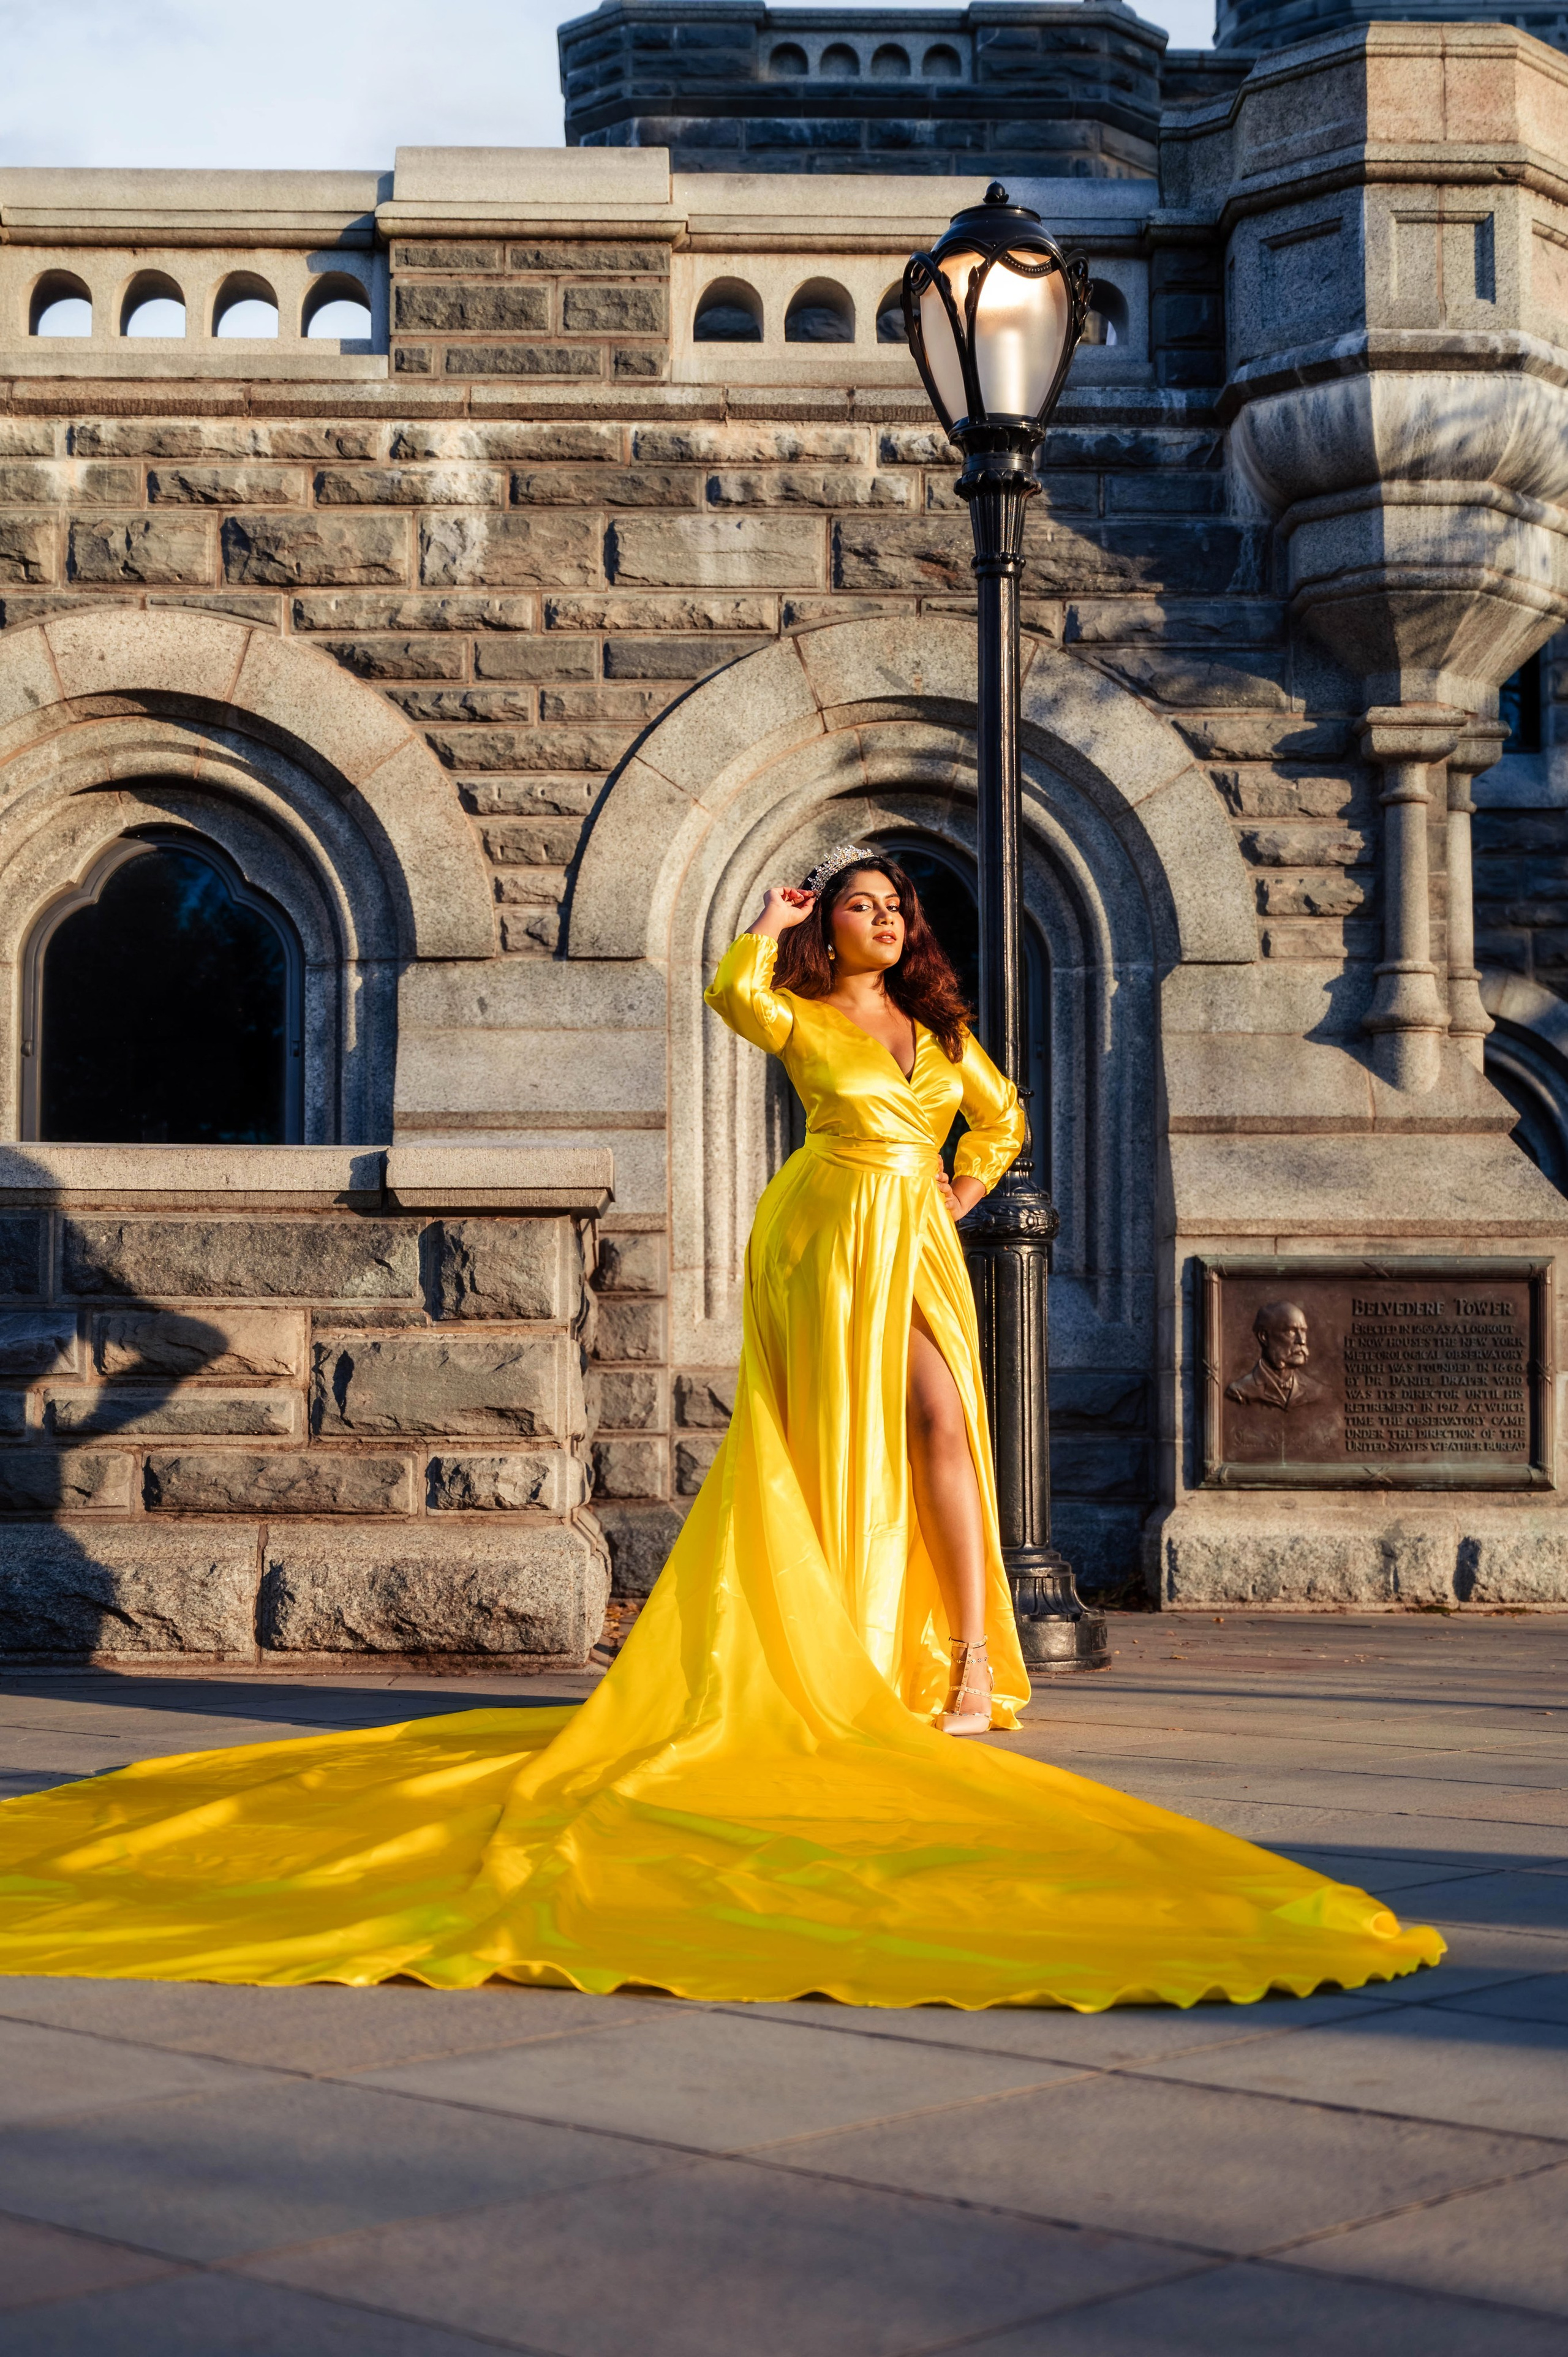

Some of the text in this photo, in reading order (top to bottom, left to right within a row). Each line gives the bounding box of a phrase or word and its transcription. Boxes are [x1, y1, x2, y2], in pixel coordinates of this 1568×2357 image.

[1352, 1298, 1513, 1316] BELVEDERE TOWER
[1352, 1323, 1397, 1335] ERECTED
[1399, 1324, 1409, 1334] IN
[1436, 1324, 1452, 1334] AS
[1452, 1324, 1461, 1334] A
[1463, 1324, 1515, 1335] LOOKOUT
[1344, 1336, 1525, 1348] IT NOW HOUSES THE NEW YORK
[1344, 1349, 1523, 1360] METEOROLOGICAL OBSERVATORY
[1344, 1363, 1385, 1373] WHICH
[1389, 1363, 1414, 1373] WAS
[1418, 1363, 1471, 1372] FOUNDED
[1476, 1363, 1488, 1372] IN
[1344, 1376, 1360, 1386] BY
[1390, 1375, 1434, 1386] DANIEL
[1441, 1375, 1488, 1386] DRAPER
[1493, 1376, 1522, 1386] WHO
[1345, 1389, 1523, 1400] WAS ITS DIRECTOR UNTIL HIS
[1344, 1403, 1417, 1413] RETIREMENT
[1420, 1403, 1433, 1412] IN
[1466, 1403, 1483, 1413] AT
[1485, 1403, 1525, 1412] WHICH
[1344, 1416, 1526, 1426] TIME THE OBSERVATORY CAME
[1344, 1429, 1526, 1439] UNDER THE DIRECTION OF THE
[1345, 1441, 1526, 1452] UNITED STATES WEATHER BUREAU
